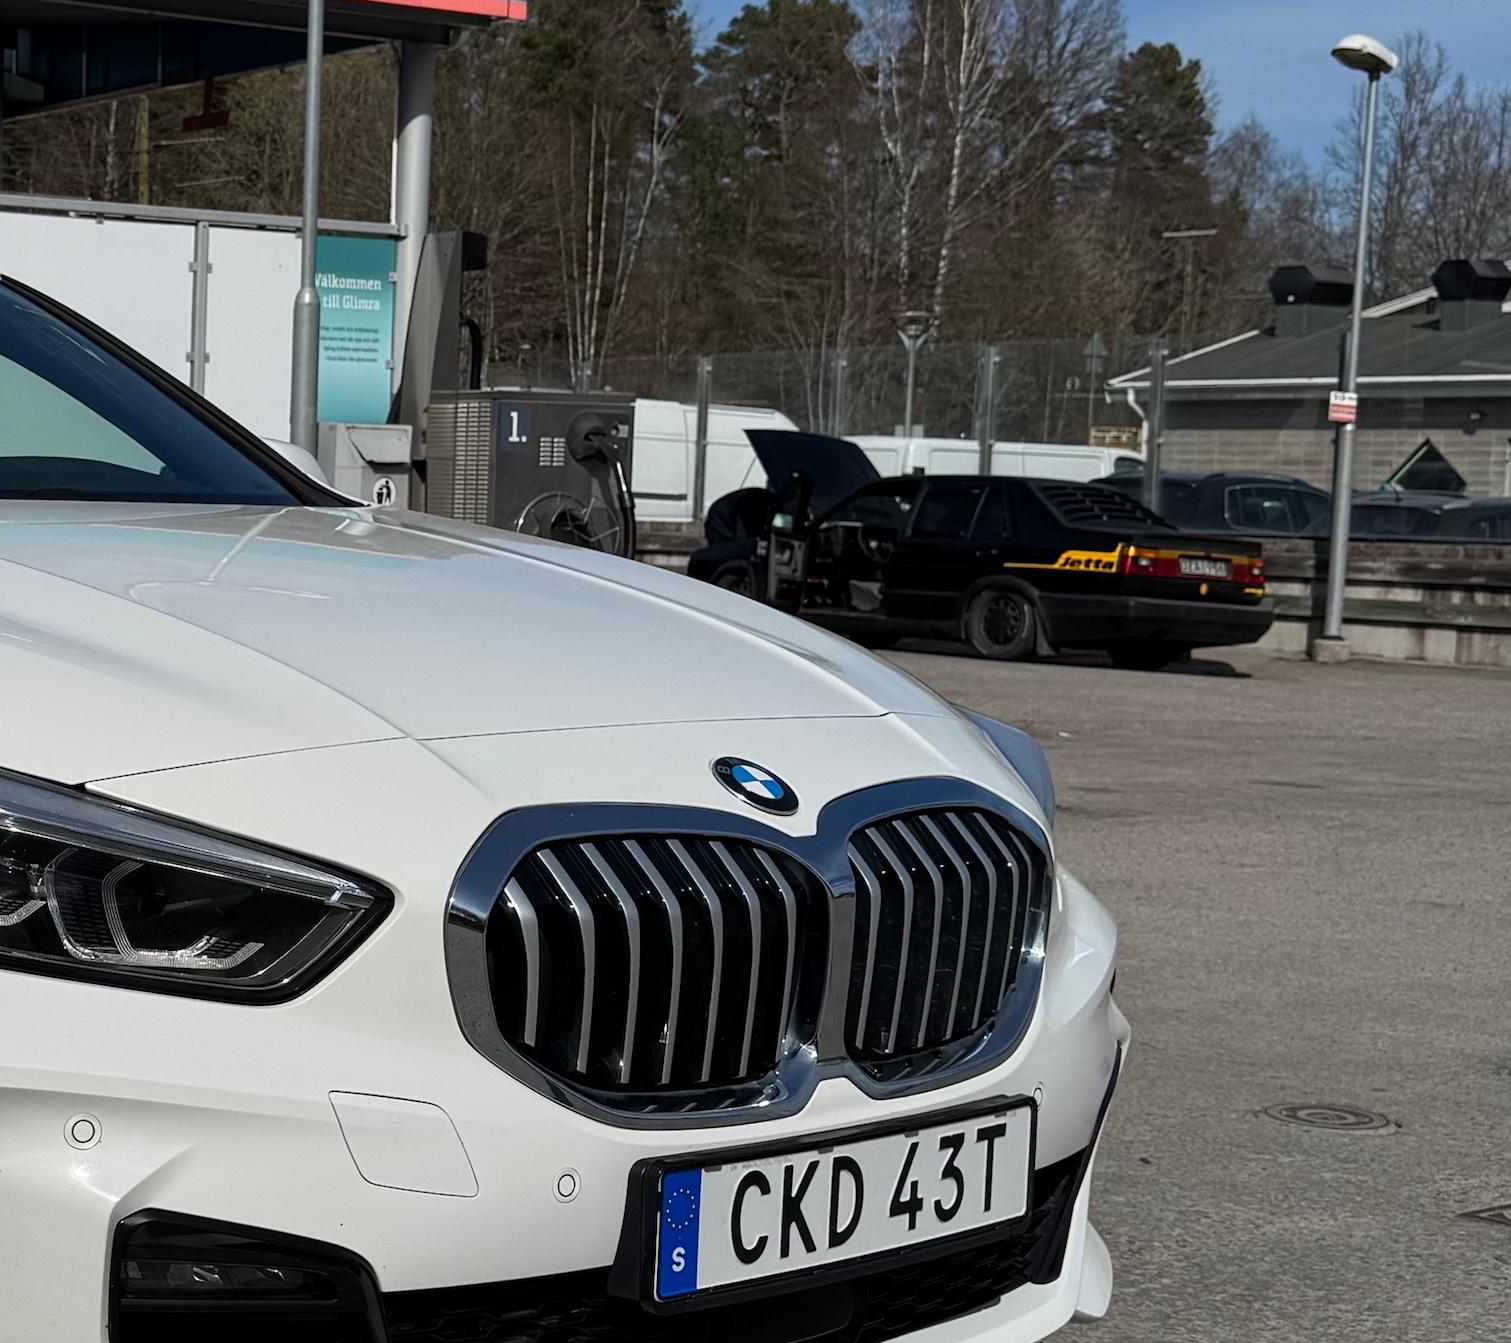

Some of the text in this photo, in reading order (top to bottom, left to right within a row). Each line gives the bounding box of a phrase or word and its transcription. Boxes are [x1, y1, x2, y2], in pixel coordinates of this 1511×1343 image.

[315, 273, 382, 291] Välkommen
[323, 294, 381, 311] till Glimra
[731, 1123, 1007, 1264] CKD 43T
[671, 1246, 686, 1273] S
